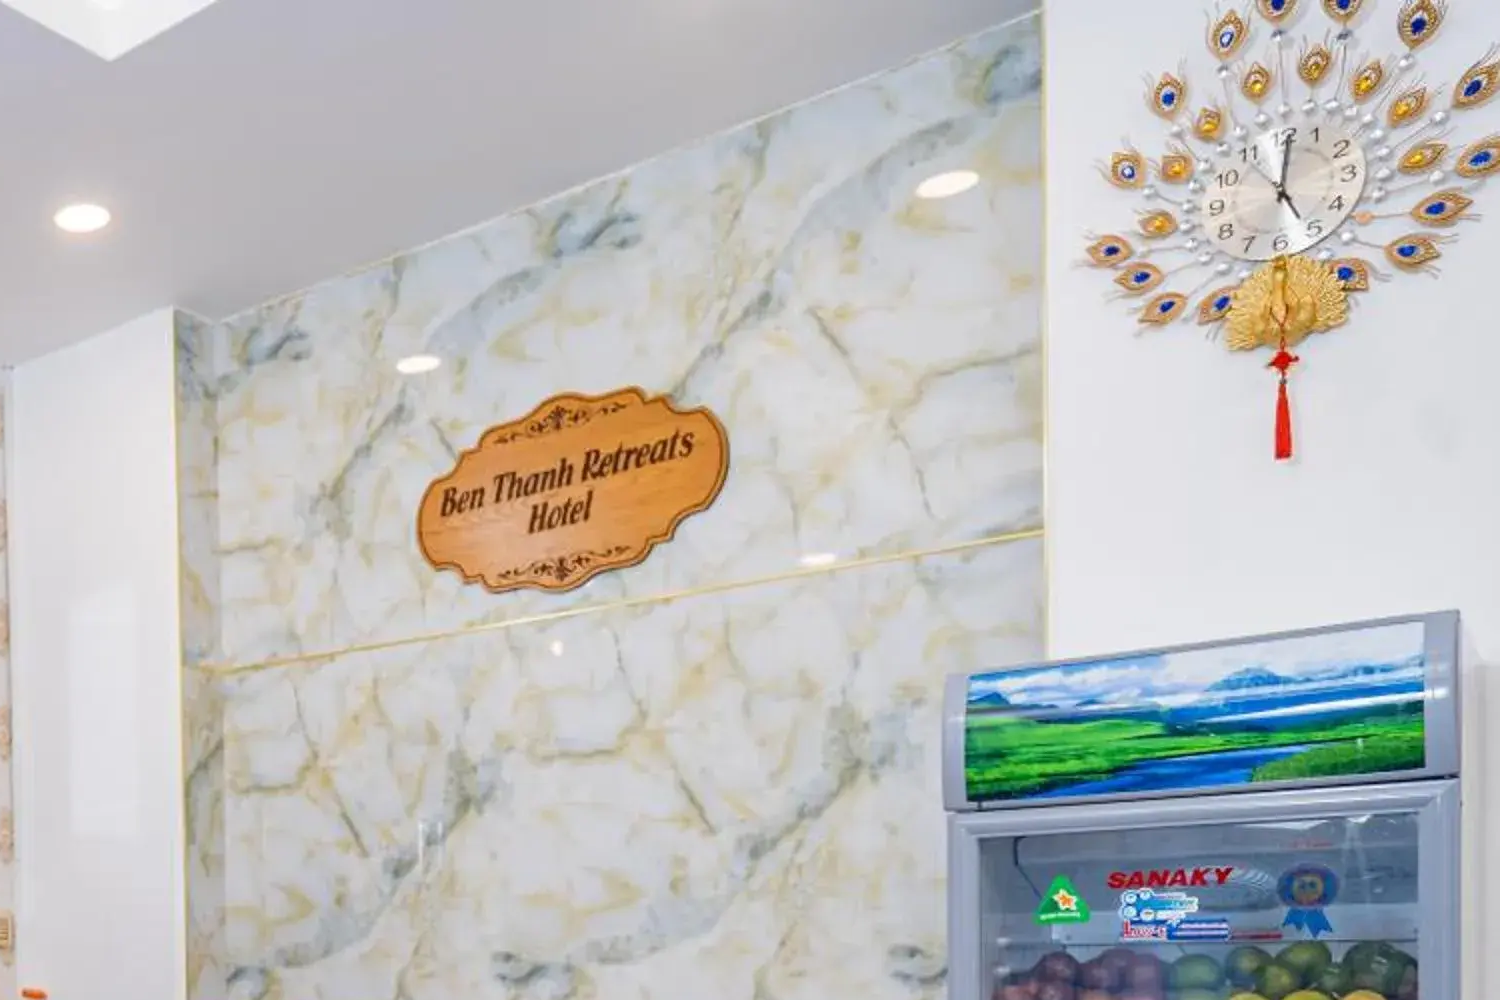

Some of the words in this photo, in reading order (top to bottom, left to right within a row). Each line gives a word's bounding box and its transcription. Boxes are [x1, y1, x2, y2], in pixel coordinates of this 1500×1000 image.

[1273, 128, 1297, 147] 12
[1310, 127, 1319, 143] 1
[1239, 145, 1258, 162] 11
[1332, 139, 1349, 158] 2
[1216, 169, 1239, 188] 10
[1340, 165, 1357, 182] 3
[1209, 200, 1224, 216] 9
[1328, 195, 1344, 211] 4
[1218, 224, 1233, 240] 8
[1306, 219, 1323, 237] 5
[1241, 236, 1256, 253] 7
[1273, 234, 1288, 250] 6
[440, 486, 484, 517] Ben
[493, 457, 574, 503] Thanh
[581, 428, 695, 482] Retreats
[528, 490, 593, 534] Hotel
[1107, 867, 1234, 889] SANAKY
